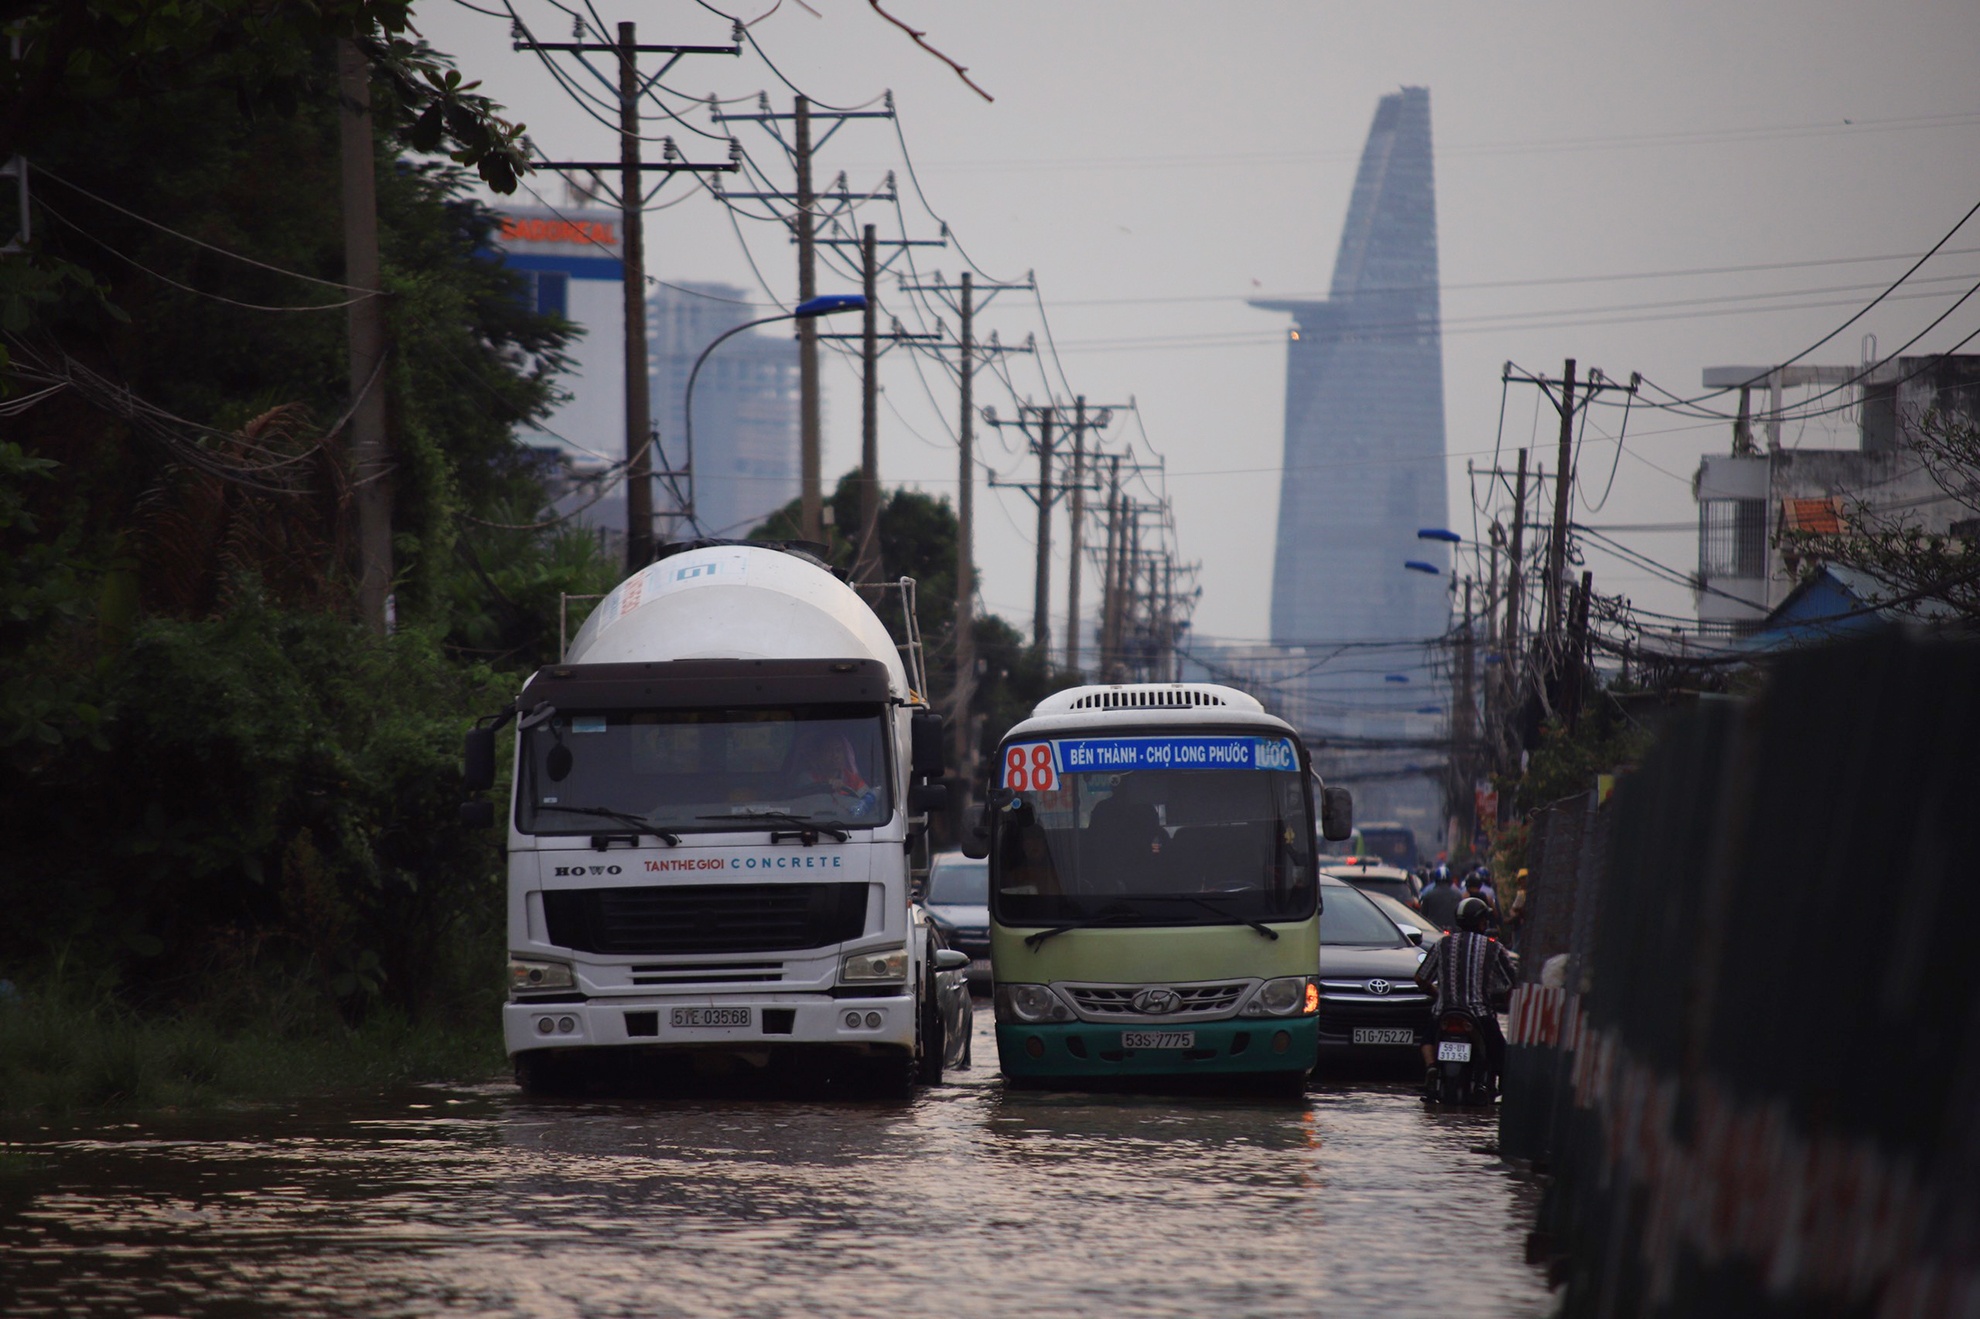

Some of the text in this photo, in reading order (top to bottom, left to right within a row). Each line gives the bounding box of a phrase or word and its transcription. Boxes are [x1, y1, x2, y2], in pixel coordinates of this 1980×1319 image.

[1070, 741, 1094, 766] BẾN
[1097, 743, 1137, 765] THÀNH
[1146, 744, 1171, 768] CHỢ
[1175, 746, 1206, 763] LONG
[1209, 742, 1249, 763] PHƯỚC
[1007, 744, 1053, 792] 88
[555, 865, 622, 876] HOWO
[731, 857, 841, 869] CONCRETE
